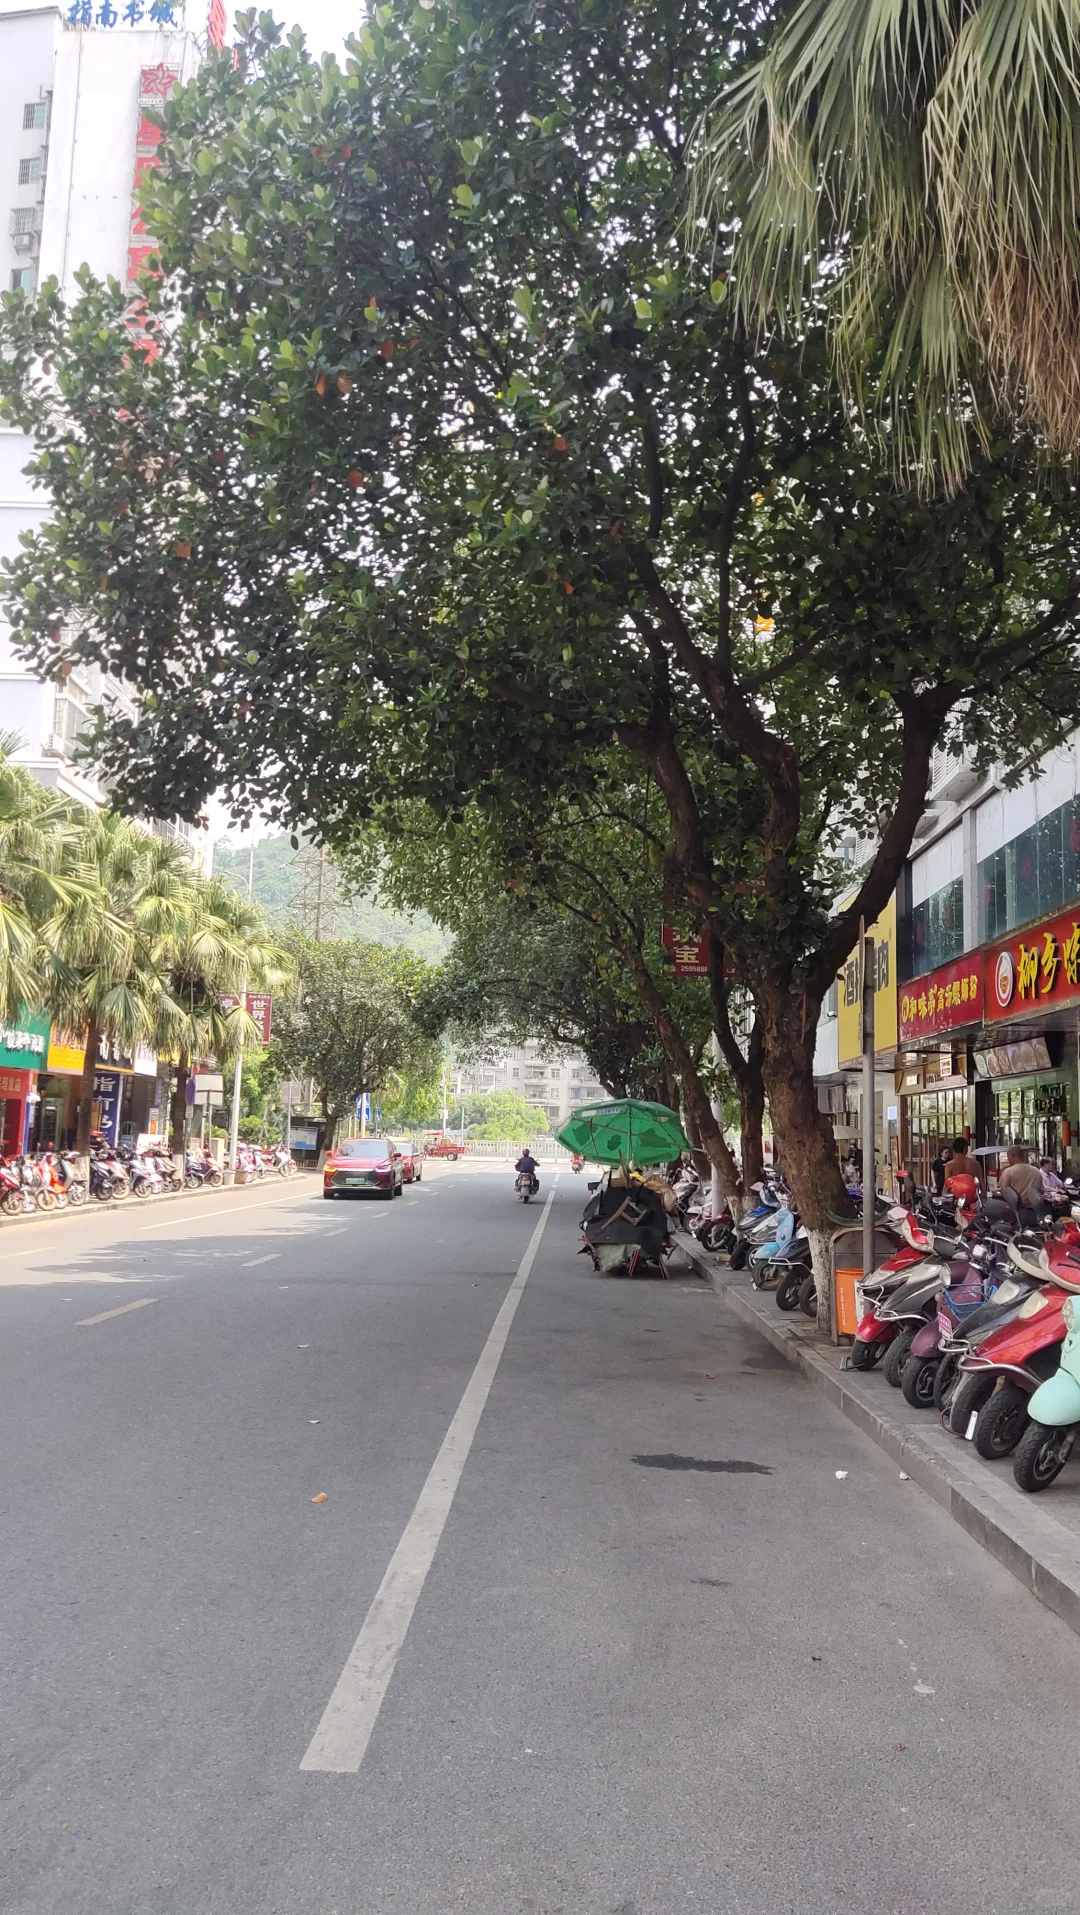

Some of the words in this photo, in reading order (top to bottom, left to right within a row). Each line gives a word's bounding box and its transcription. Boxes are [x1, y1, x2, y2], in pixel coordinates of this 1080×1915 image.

[67, 0, 178, 28] 指南书城
[0, 1076, 21, 1092] 理发店
